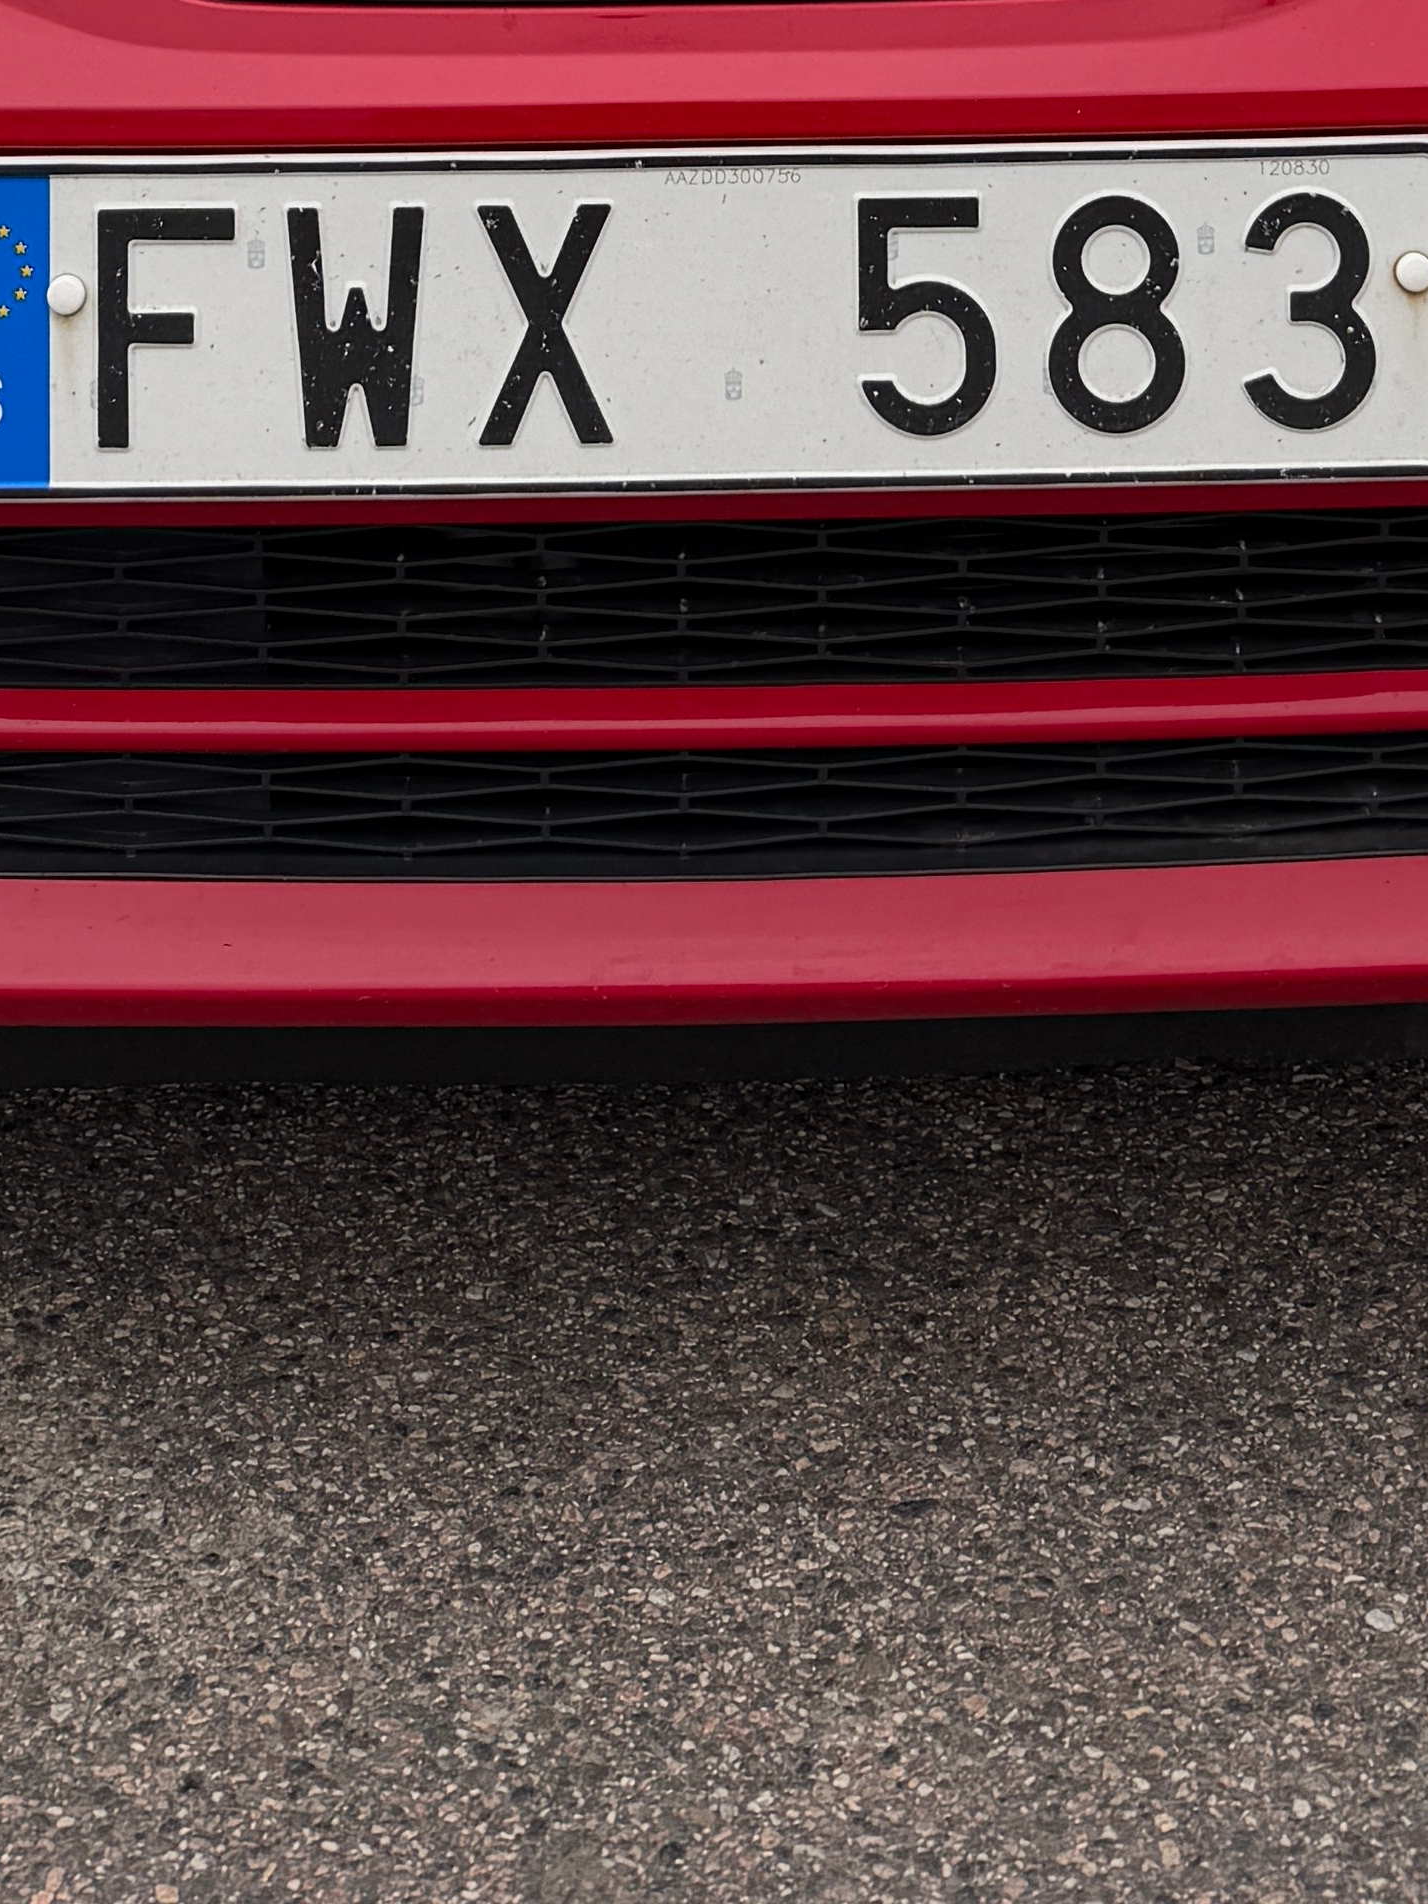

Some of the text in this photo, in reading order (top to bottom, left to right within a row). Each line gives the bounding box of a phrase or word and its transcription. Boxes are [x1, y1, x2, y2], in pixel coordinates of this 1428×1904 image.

[1259, 158, 1330, 176] 120830
[97, 191, 1377, 449] FWX 583
